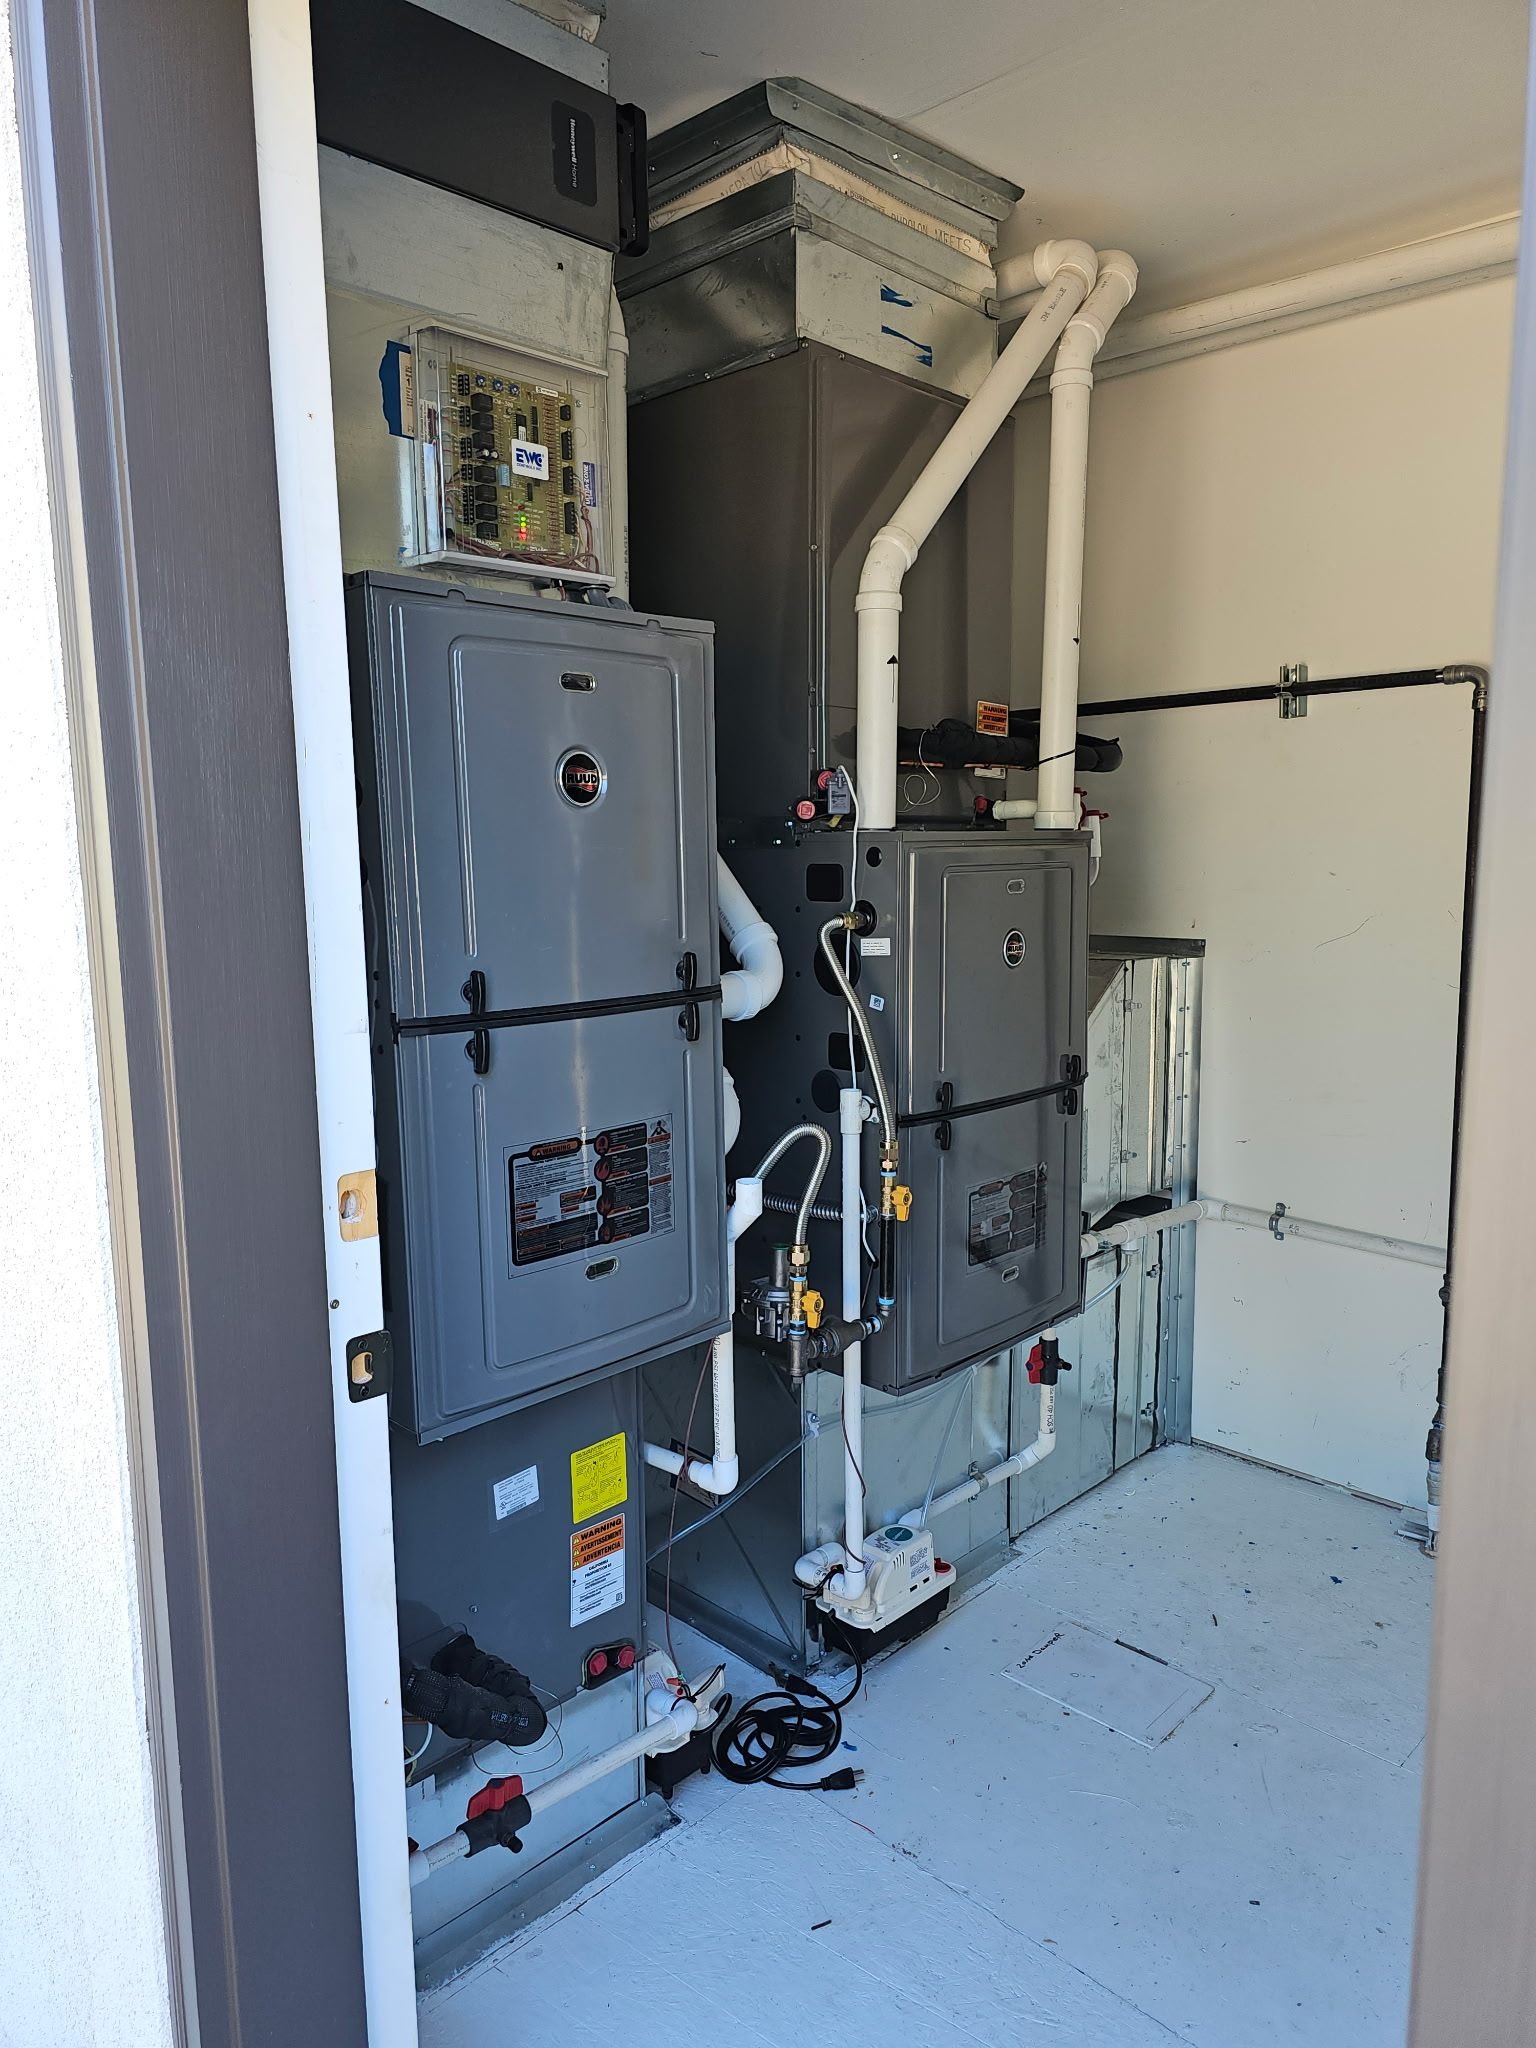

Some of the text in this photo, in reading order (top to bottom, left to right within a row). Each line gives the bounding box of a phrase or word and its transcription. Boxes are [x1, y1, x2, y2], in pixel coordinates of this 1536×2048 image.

[569, 118, 577, 163] Honeywell
[934, 229, 971, 254] MEETS
[515, 448, 543, 468] EWC
[566, 773, 597, 784] RUUD
[1047, 1405, 1053, 1413] 40
[580, 1518, 622, 1541] WARNING
[580, 1528, 623, 1553] AVERTISSEMENT
[583, 1541, 621, 1563] ADVERTENCIA
